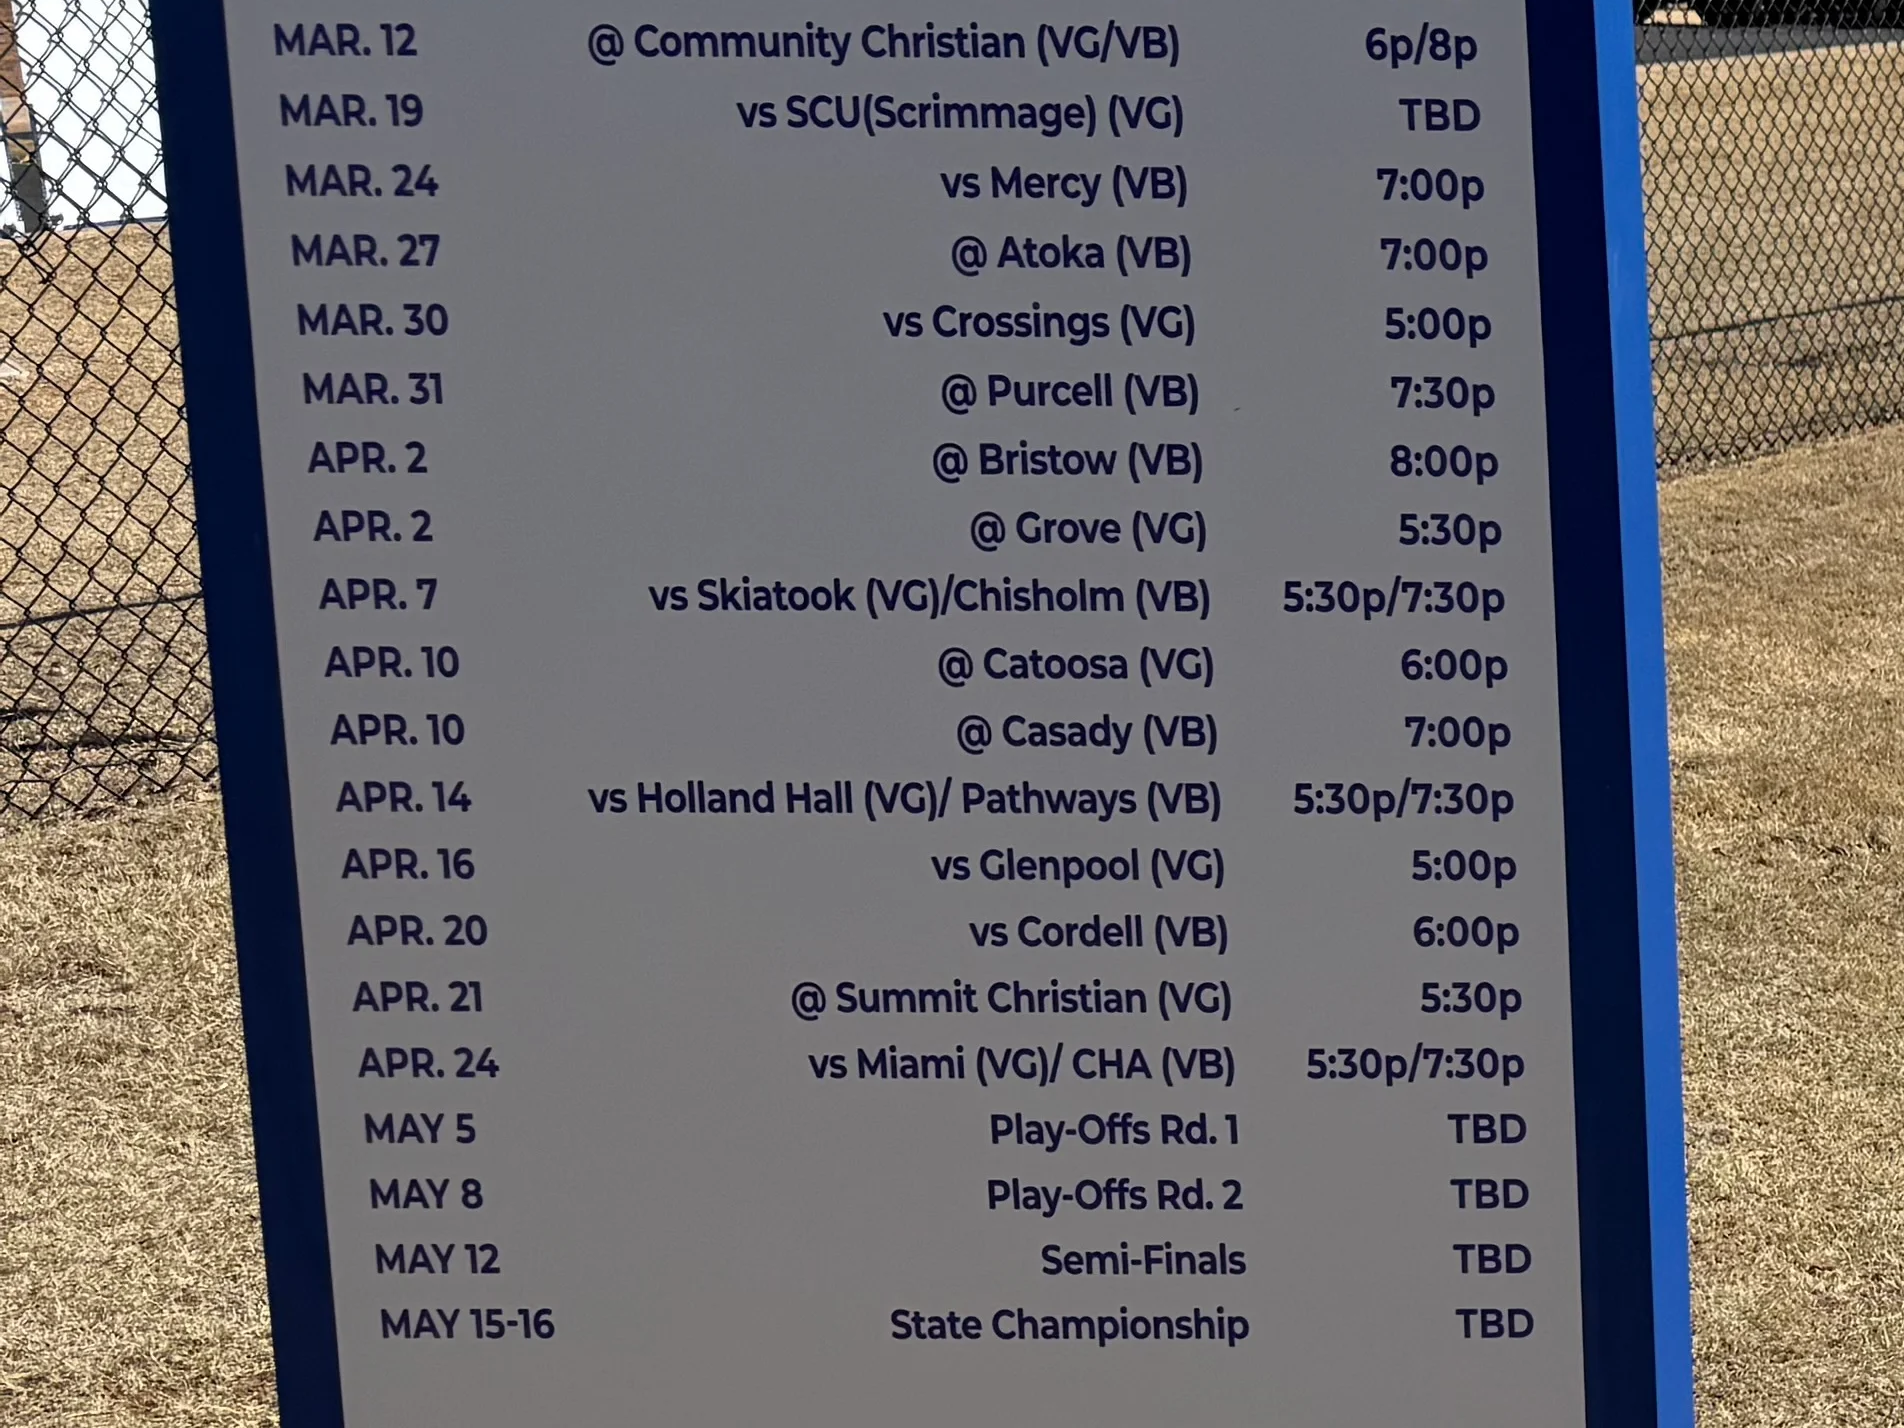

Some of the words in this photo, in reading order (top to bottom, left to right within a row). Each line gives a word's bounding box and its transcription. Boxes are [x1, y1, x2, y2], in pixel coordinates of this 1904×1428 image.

[273, 23, 372, 57] MAR.
[380, 22, 419, 57] 12
[588, 24, 625, 68] @
[634, 21, 853, 68] Community
[861, 21, 1026, 60] Christian
[1037, 19, 1180, 69] (VG/VB)
[1365, 22, 1478, 71] 6p/8p
[341, 848, 430, 880] APR.
[436, 847, 476, 880] 16
[931, 856, 972, 881] vs
[980, 848, 1141, 889] Glenpool
[1151, 848, 1225, 890] (VG)
[1412, 849, 1518, 890] 5:00p
[364, 1113, 445, 1145] MAY
[456, 1113, 477, 1145] 5
[991, 1112, 1151, 1154] Play-Offs
[1161, 1113, 1218, 1146] Rd.
[1224, 1114, 1239, 1146] 1
[1447, 1114, 1528, 1145] TBD
[380, 1309, 461, 1339] MAY
[469, 1308, 556, 1340] 15-16
[890, 1309, 984, 1341] State
[992, 1305, 1251, 1349] Championship
[1455, 1308, 1535, 1339] TBD
